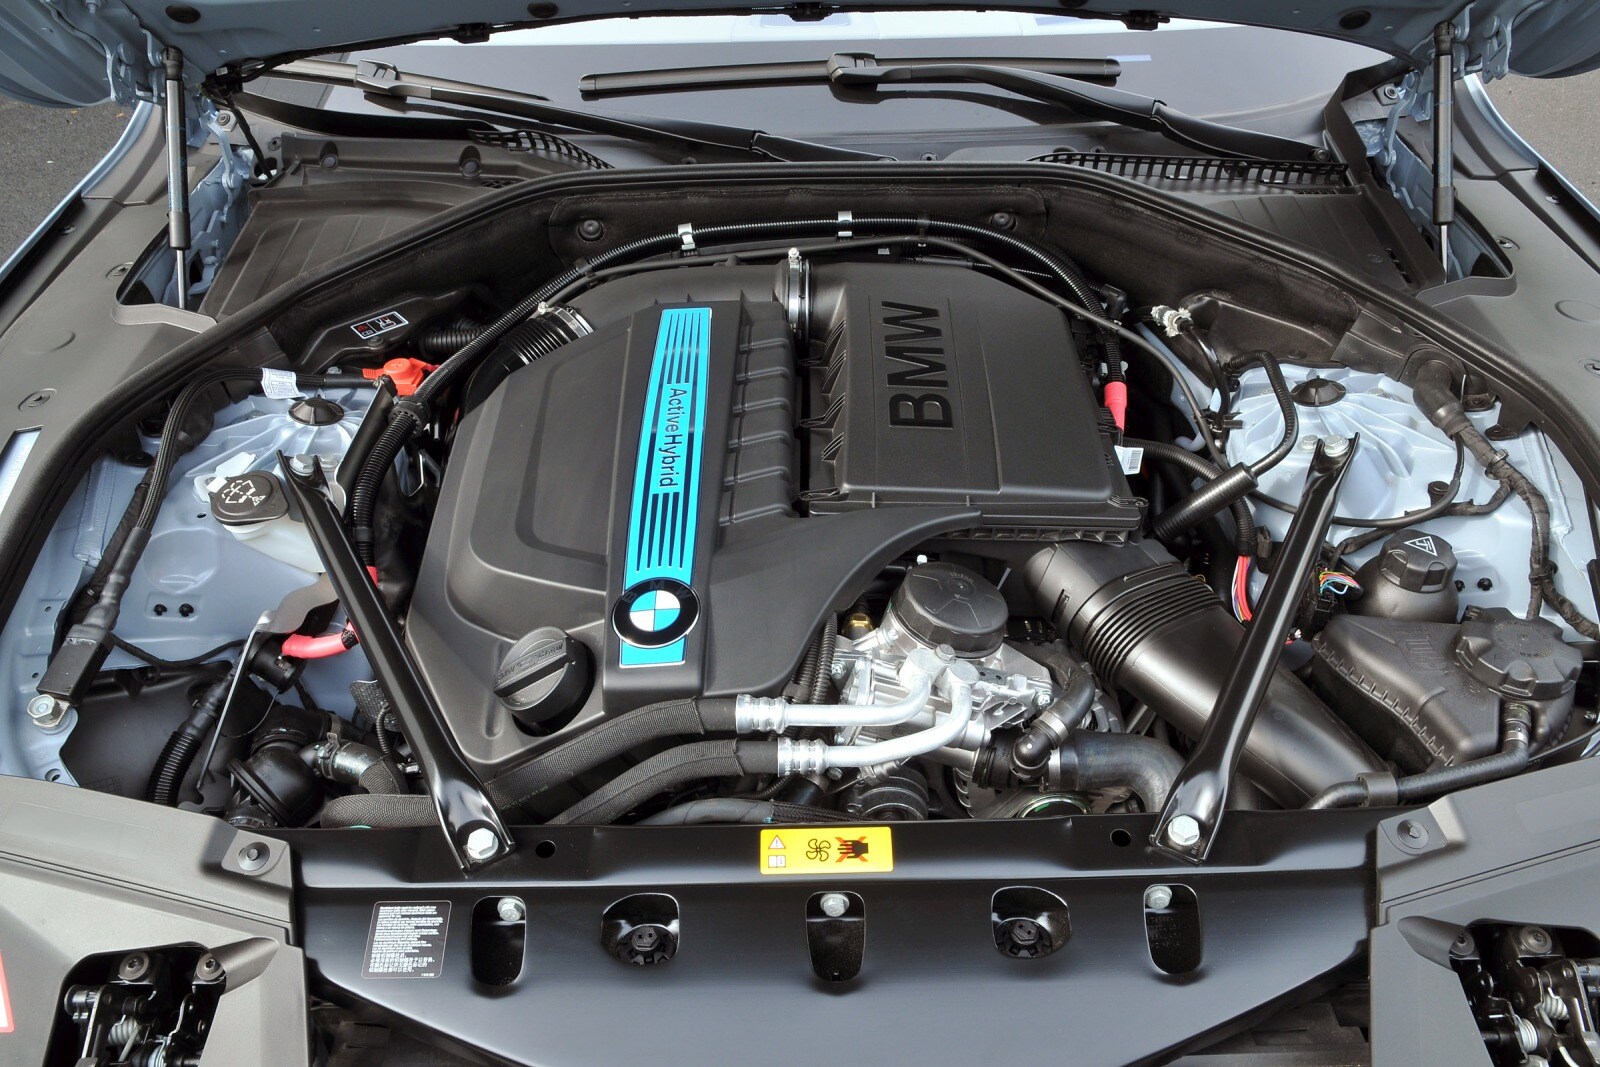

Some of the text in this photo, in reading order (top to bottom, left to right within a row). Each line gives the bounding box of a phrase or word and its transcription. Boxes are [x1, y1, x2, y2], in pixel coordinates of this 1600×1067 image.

[881, 300, 954, 430] BMW
[658, 387, 687, 488] ActiveHybrid
[621, 579, 693, 604] BMW
